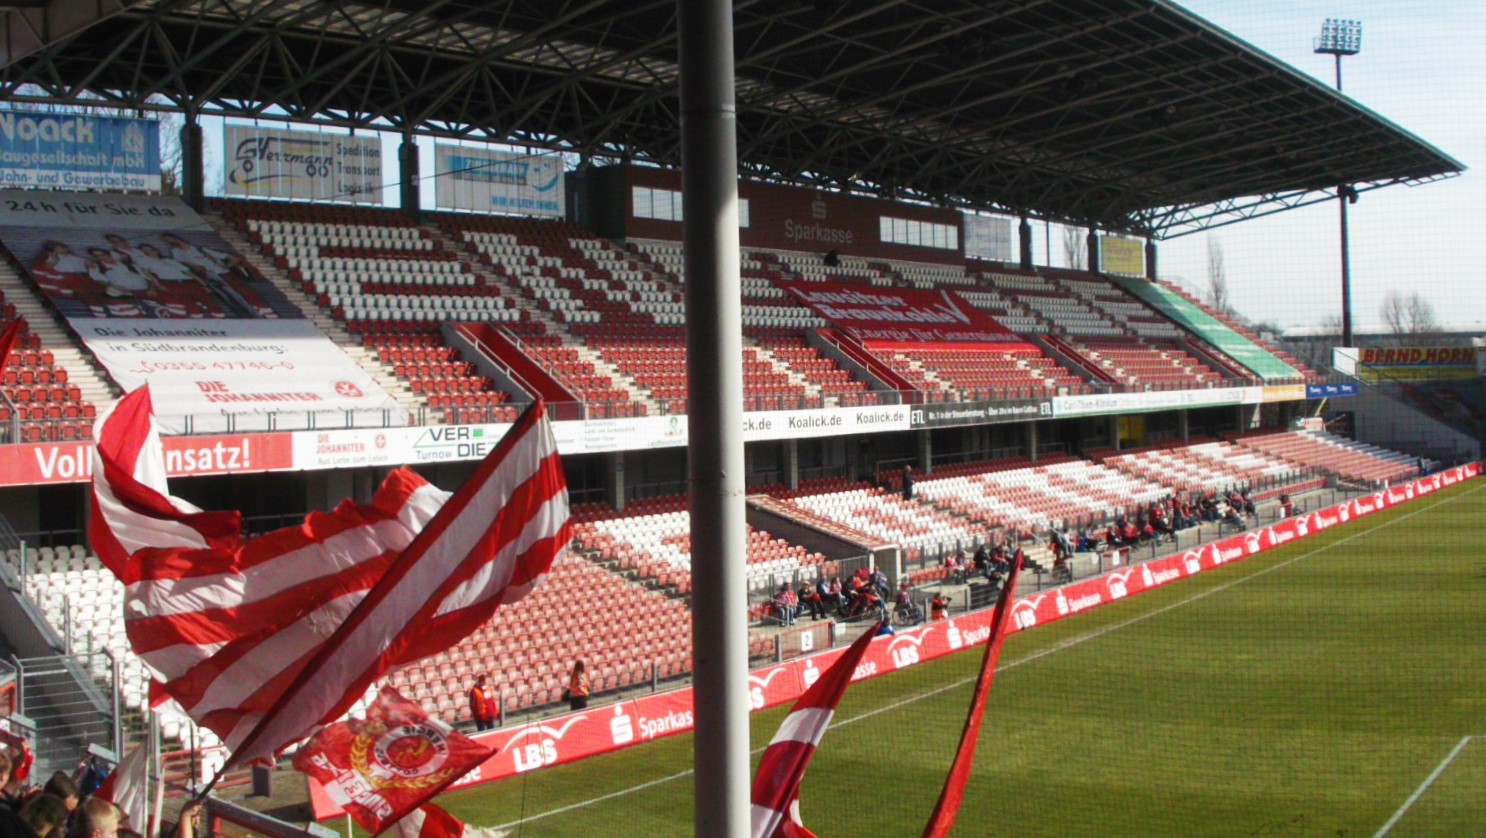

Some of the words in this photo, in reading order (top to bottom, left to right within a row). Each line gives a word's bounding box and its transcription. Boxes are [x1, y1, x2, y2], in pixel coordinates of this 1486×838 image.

[337, 143, 380, 157] Spedition
[0, 150, 108, 168] augesellschaft
[112, 153, 145, 168] mbH
[338, 162, 380, 176] Transport
[37, 172, 59, 183] und
[64, 173, 145, 187] Gewerbebau
[63, 201, 98, 214] für
[104, 203, 143, 215] Sie
[148, 204, 176, 217] da
[785, 219, 853, 243] Sparkasse
[790, 287, 907, 307] Lausitzer
[813, 303, 960, 324] Braunkohle
[95, 327, 127, 337] Die
[132, 327, 228, 338] Johanniter
[109, 343, 126, 352] in
[132, 342, 288, 355] Südbrandenburg:
[1363, 348, 1422, 364] BERND
[1426, 348, 1474, 364] HORN
[195, 381, 230, 393] DIE
[205, 392, 325, 403] JOHANNITER
[742, 418, 772, 430] ck.de
[789, 414, 842, 428] Koalick.de
[856, 411, 904, 424] Koalick.de
[912, 410, 925, 424] ETL
[317, 434, 330, 443] DIE
[429, 427, 469, 441] VER
[317, 443, 365, 454] JOHANNITER
[416, 450, 452, 460] Turnow
[457, 443, 486, 458] DIE
[34, 446, 93, 478] Voll
[166, 438, 251, 473] nsatz!
[805, 634, 810, 647] 2
[512, 739, 558, 772] LBS
[638, 709, 693, 737] Sparkas
[893, 645, 920, 668] LBS
[963, 625, 991, 646] Sparka
[1014, 609, 1037, 630] LBS
